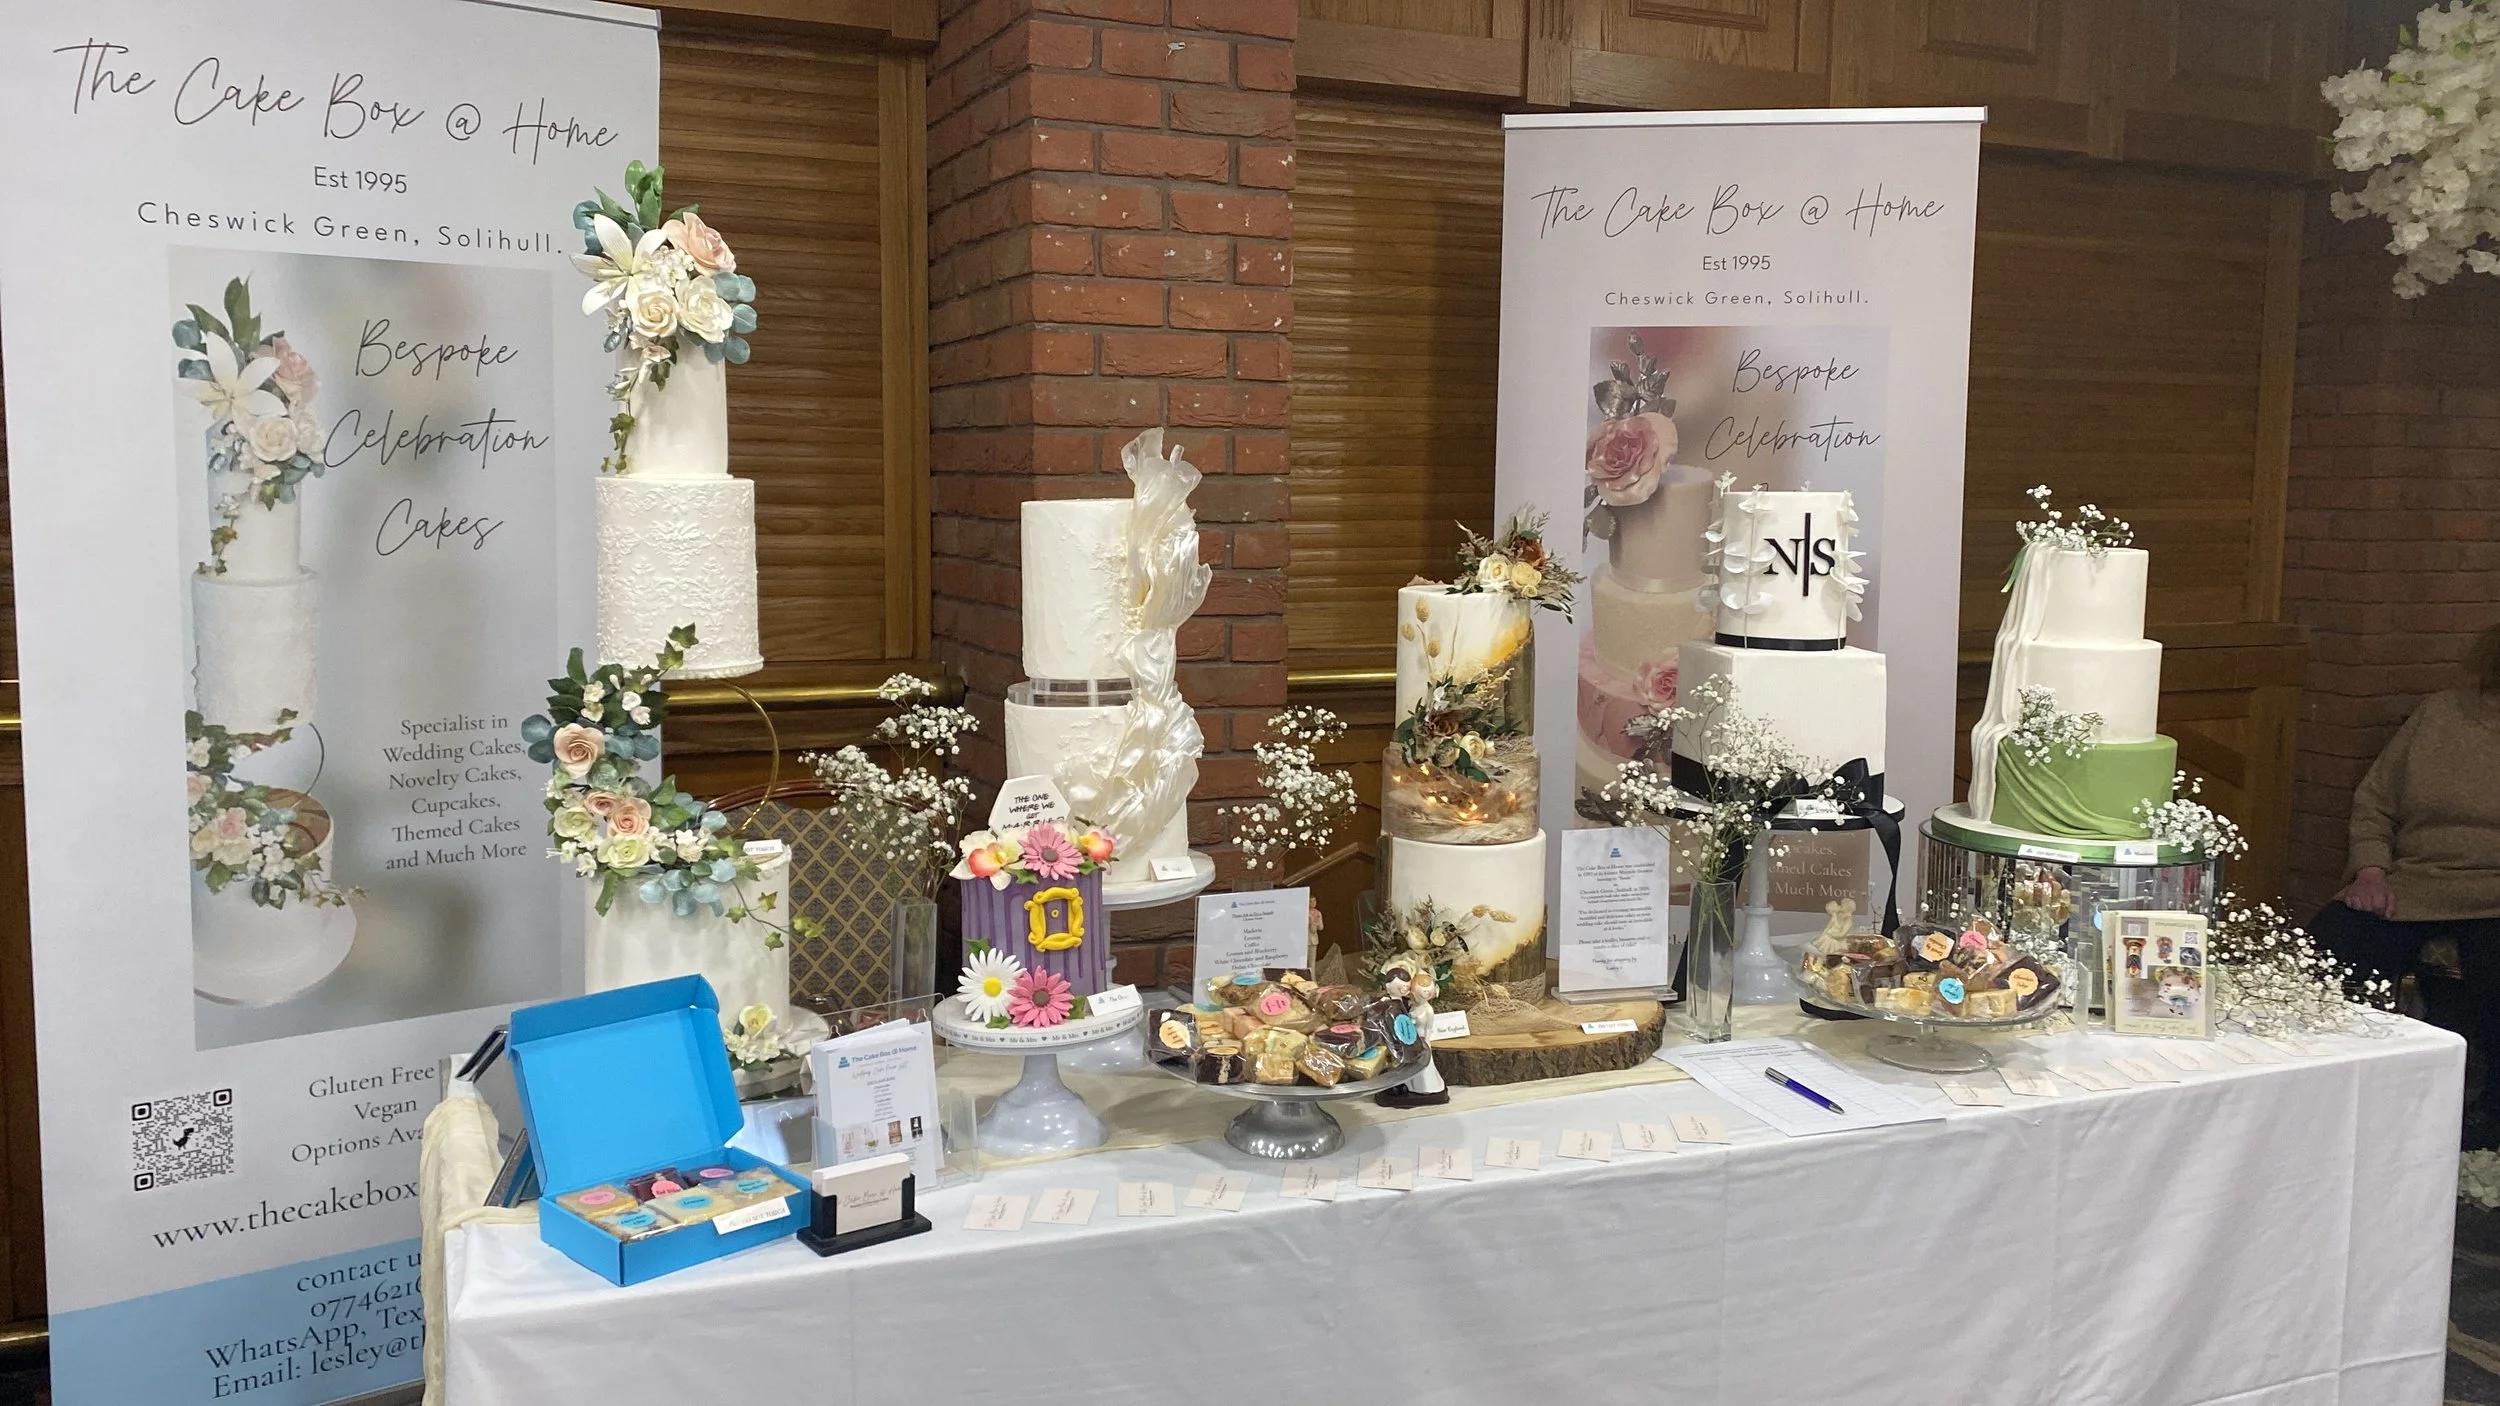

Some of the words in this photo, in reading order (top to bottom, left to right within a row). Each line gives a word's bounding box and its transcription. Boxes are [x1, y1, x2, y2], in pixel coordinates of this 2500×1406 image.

[53, 37, 156, 114] The
[174, 57, 304, 126] Cake
[323, 73, 425, 139] Box
[445, 103, 481, 140] @
[502, 97, 618, 165] Home
[313, 166, 348, 190] Est
[355, 169, 408, 195] 1995
[1531, 184, 1594, 239] The
[1604, 186, 1695, 238] Cake
[1706, 183, 1784, 235] Box
[1800, 195, 1829, 226] @
[1845, 182, 1945, 237] Home
[137, 201, 296, 235] Cheswick
[314, 215, 420, 247] Green,
[438, 225, 564, 255] Solihull.
[1703, 256, 1727, 271] Est
[1733, 255, 1771, 271] 1995
[1605, 290, 1695, 306] Cheswick
[1705, 291, 1772, 306] Green,
[1784, 290, 1870, 305] Solihull.
[355, 319, 518, 381] Bespoke
[1732, 349, 1860, 393] Bespoke
[324, 407, 549, 469] Celebration
[1705, 415, 1881, 462] Celebration
[376, 498, 504, 556] Cakes
[401, 714, 485, 740] Specialist
[492, 715, 508, 730] in
[383, 743, 465, 763] Wedding
[469, 738, 527, 756] Cakes,
[389, 769, 459, 790] Novelty
[465, 765, 522, 783] Cakes,
[412, 792, 501, 817] Cupcakes,
[1009, 803, 1039, 813] WHERE
[1041, 801, 1055, 809] WE
[1014, 795, 1030, 803] THE
[1032, 792, 1049, 801] ONE
[1026, 811, 1040, 819] GET
[392, 819, 462, 842] Themed
[469, 816, 520, 835] Cakes
[386, 850, 419, 870] and
[426, 845, 475, 865] Much
[482, 844, 527, 860] More
[1810, 862, 1852, 877] Cakes
[1775, 881, 1814, 896] Much
[1820, 884, 1857, 898] More
[309, 1074, 384, 1098] Gluten
[391, 1066, 435, 1086] Free
[354, 1099, 417, 1122] Vegan
[292, 1132, 381, 1166] Options
[766, 1208, 785, 1218] TOUCH
[297, 1255, 398, 1292] contact
[407, 1252, 422, 1268] u
[206, 1320, 368, 1369] WhatsApp,
[376, 1305, 424, 1330] Tex
[211, 1360, 302, 1400] Email:
